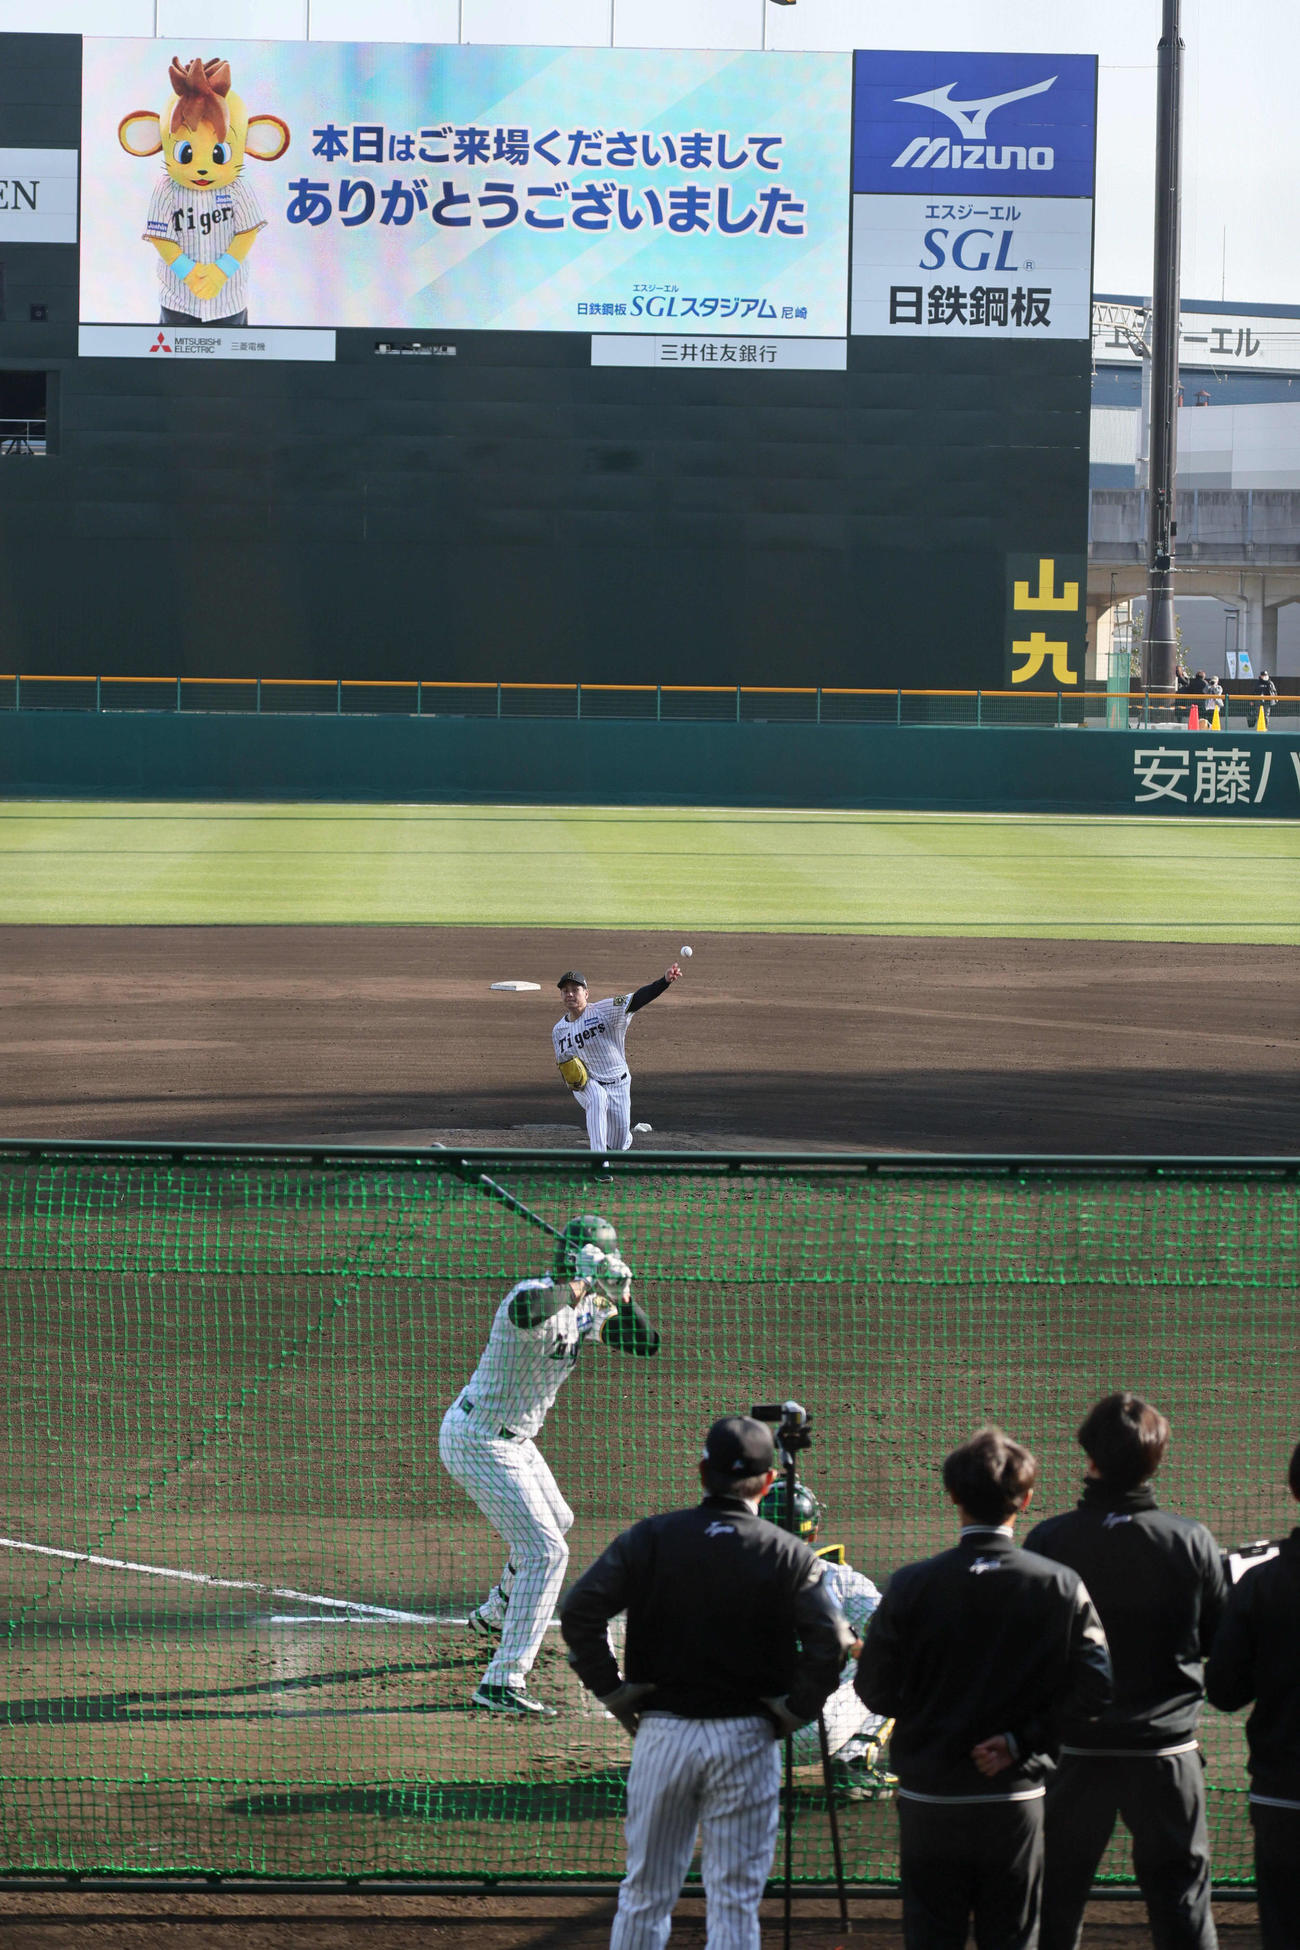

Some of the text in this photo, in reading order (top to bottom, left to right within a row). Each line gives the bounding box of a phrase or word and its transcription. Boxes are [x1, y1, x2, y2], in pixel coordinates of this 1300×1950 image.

[311, 124, 782, 171] 本日はご来場くださいまして
[286, 177, 805, 235] ありがとうございました
[925, 204, 1021, 221] エスジーエル
[919, 228, 1018, 271] SGL
[632, 284, 679, 293] エスジーエル
[577, 295, 808, 319] 日鉄鋼板 SGLスタジアム 尼崎
[889, 285, 1052, 327] 日鉄鋼板
[174, 337, 222, 346] MITSUBISHI
[231, 342, 266, 351] 三菱電機
[660, 343, 777, 363] 三井住友銀行
[1012, 559, 1079, 684] 山九
[558, 1022, 605, 1054] Tigers
